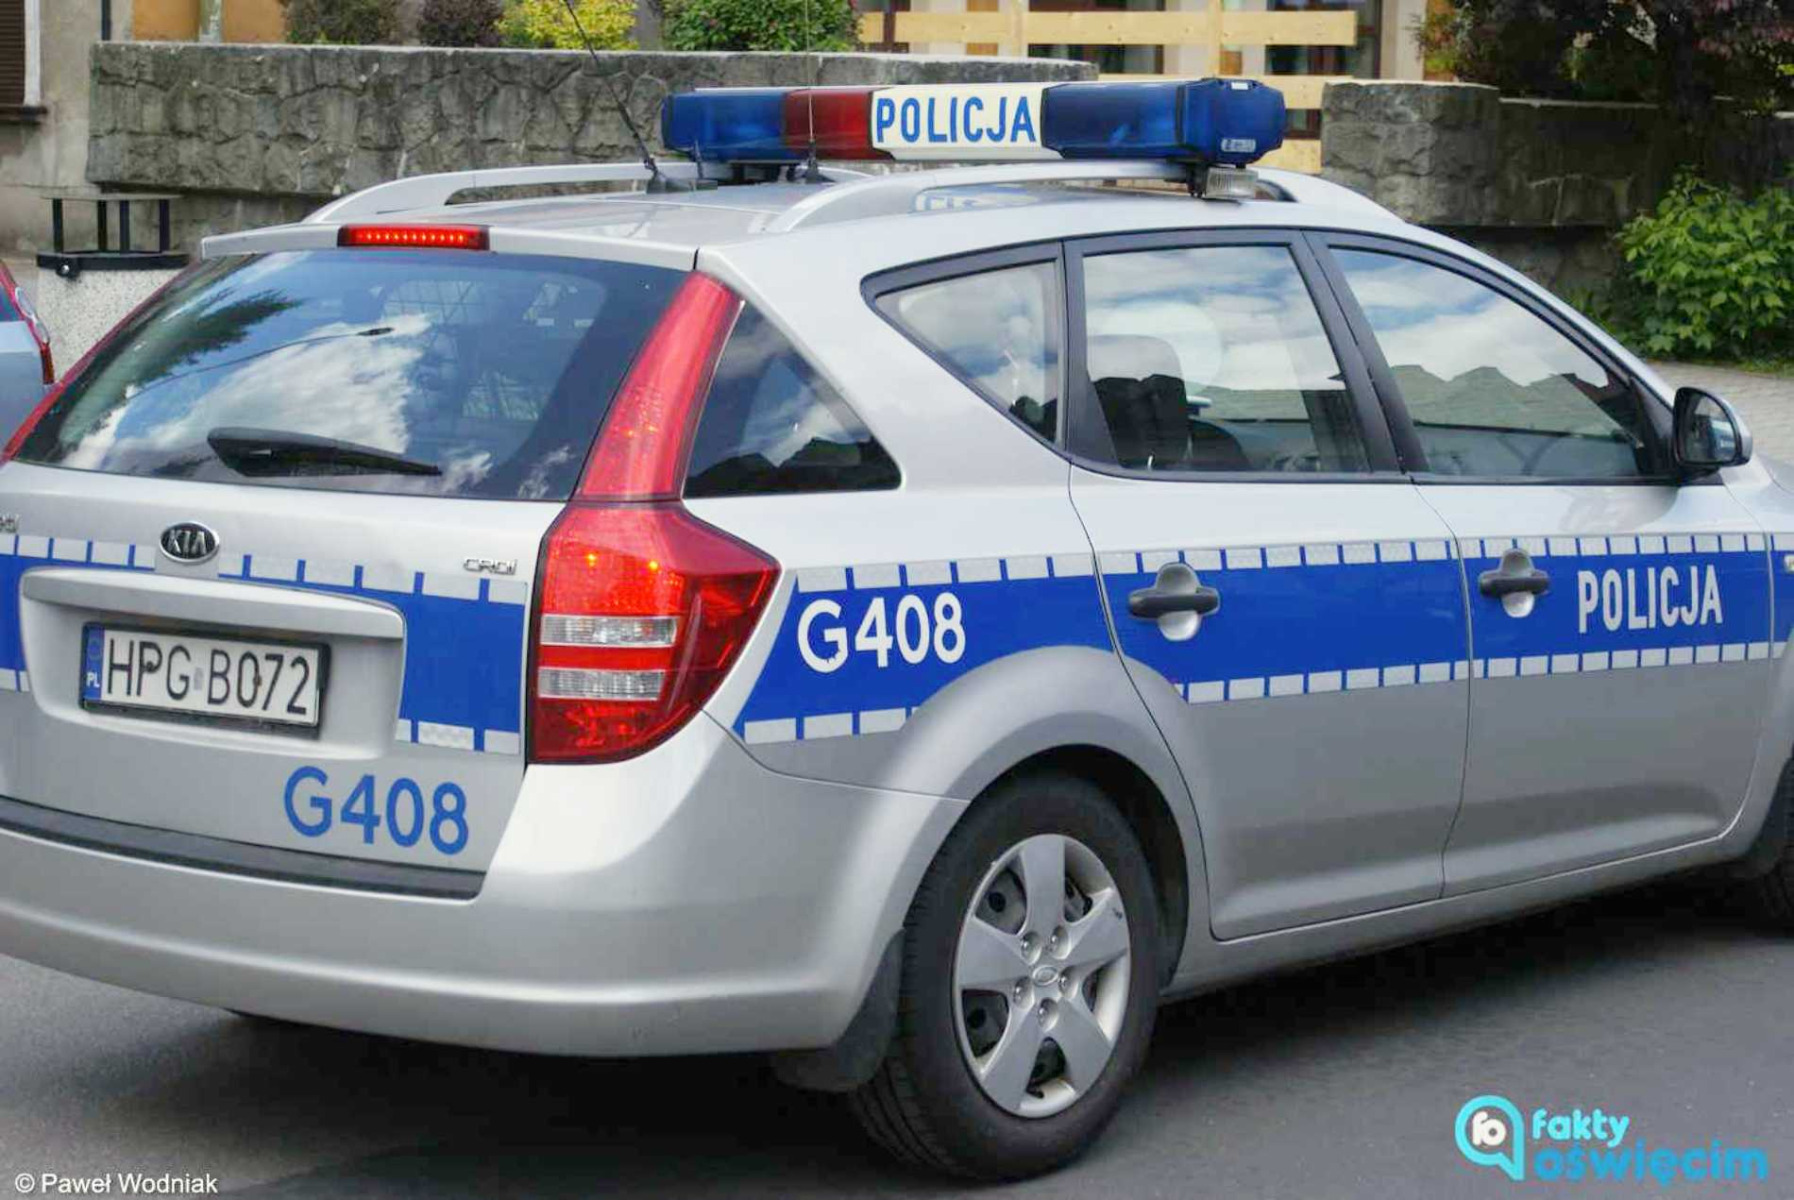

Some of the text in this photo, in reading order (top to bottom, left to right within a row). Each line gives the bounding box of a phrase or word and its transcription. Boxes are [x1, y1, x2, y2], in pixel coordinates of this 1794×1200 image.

[876, 96, 1036, 143] POLICJA
[167, 529, 209, 555] KIA
[797, 592, 966, 674] G408
[1577, 564, 1723, 634] POLICJA
[86, 671, 100, 688] PL
[107, 638, 310, 716] HPG B072
[284, 765, 469, 856] G408
